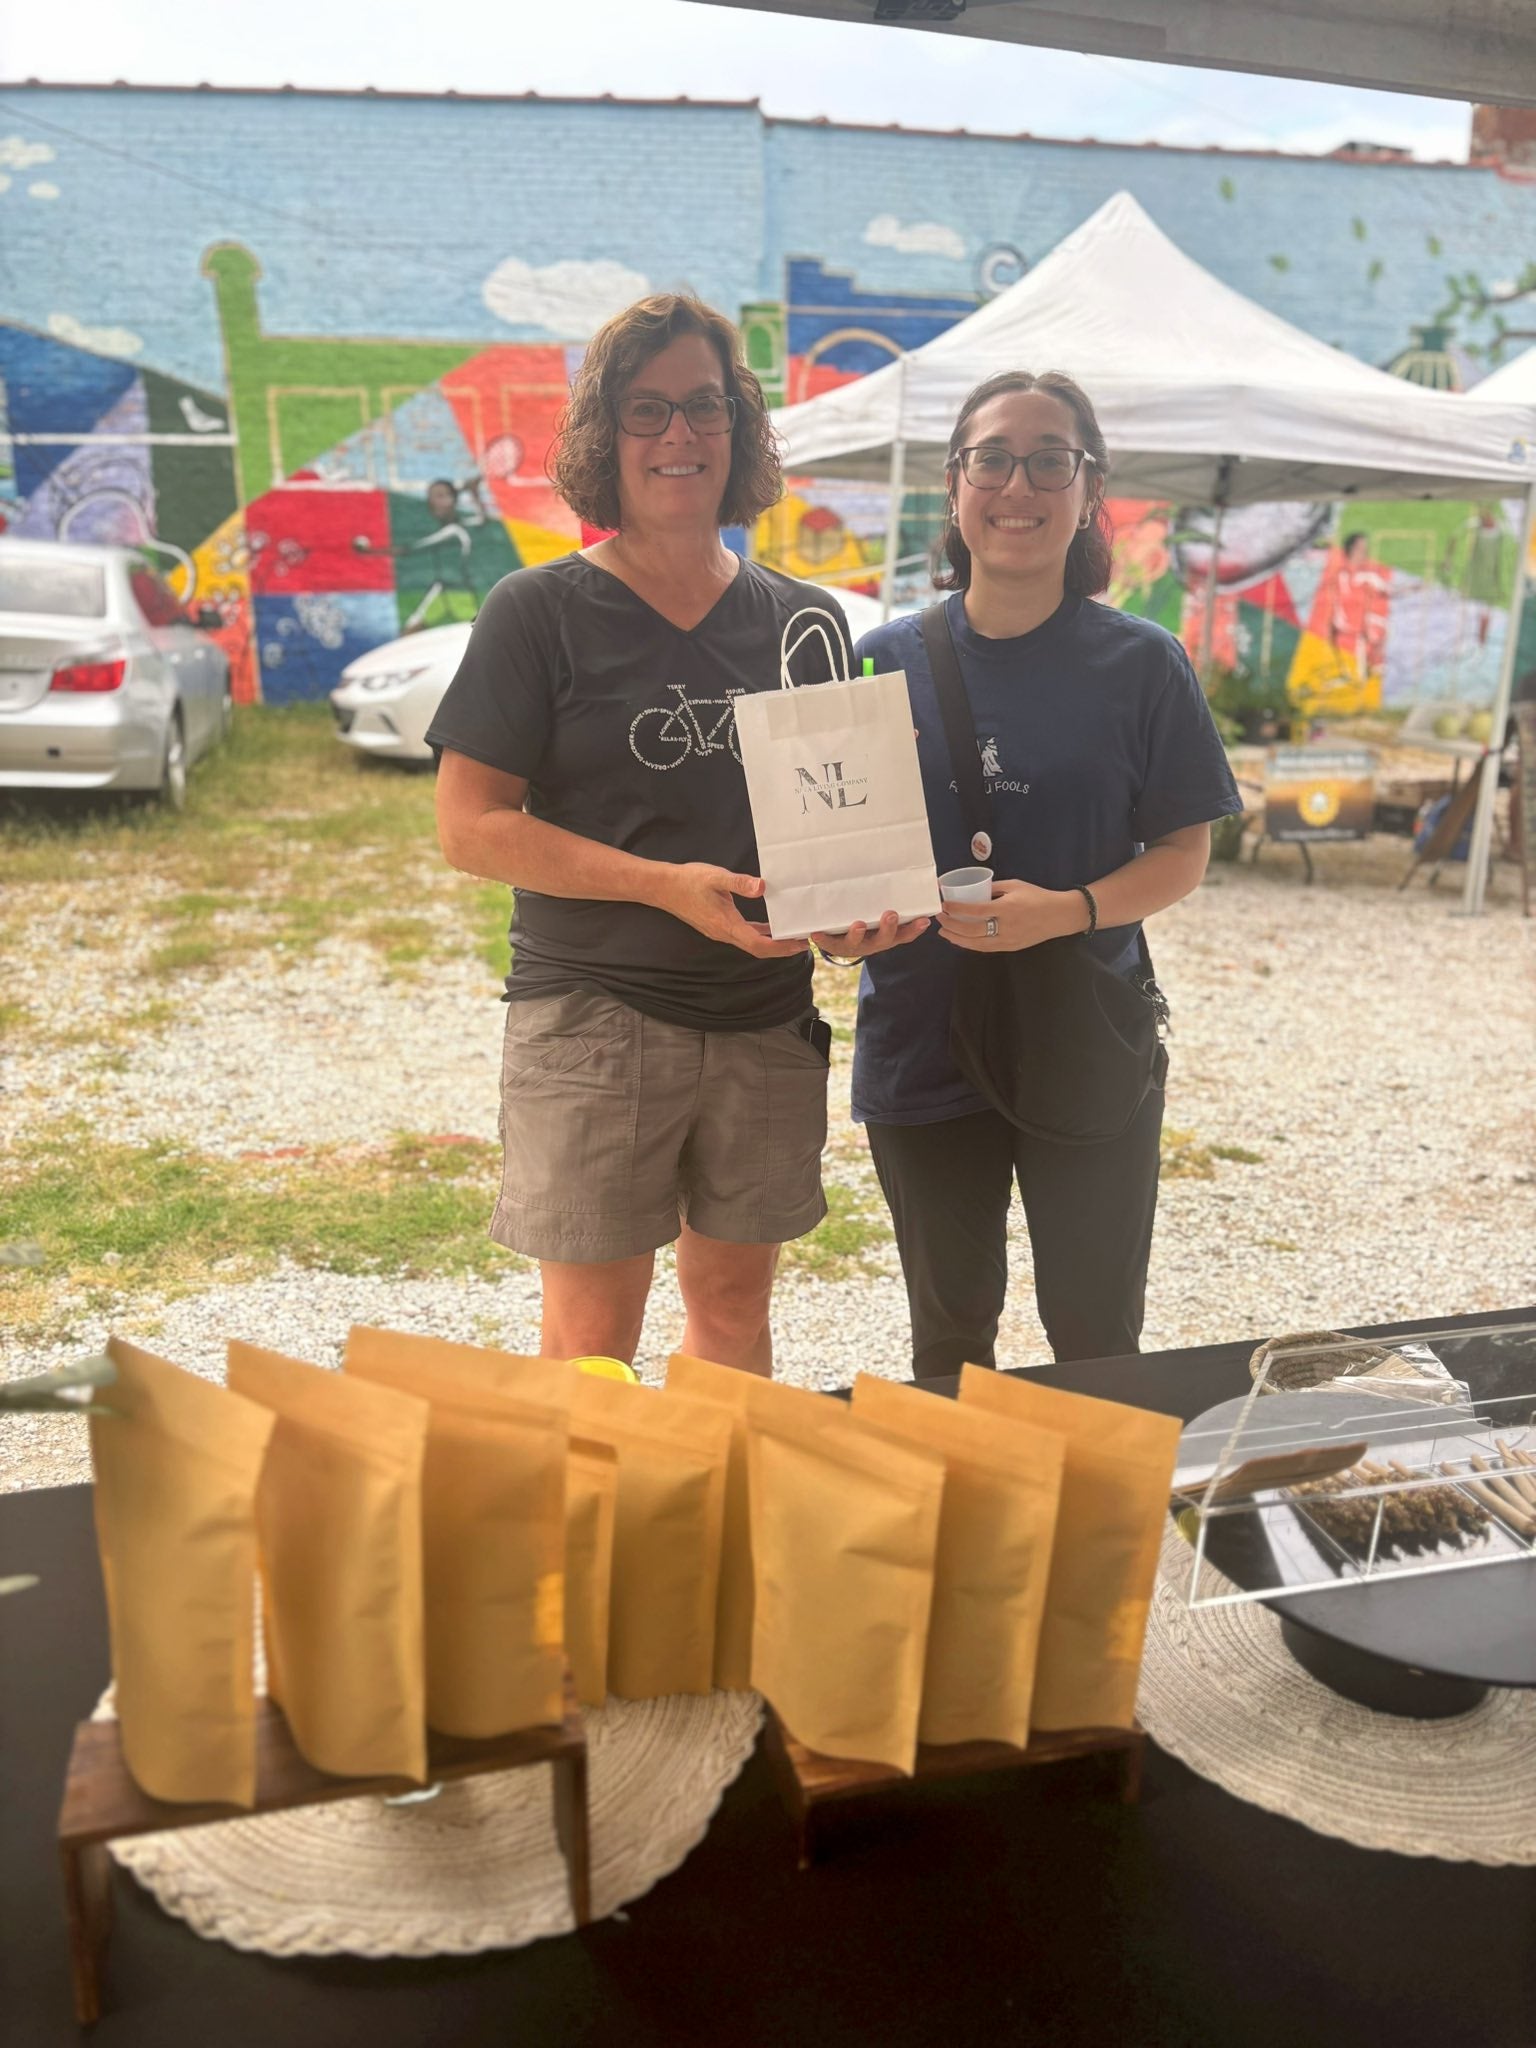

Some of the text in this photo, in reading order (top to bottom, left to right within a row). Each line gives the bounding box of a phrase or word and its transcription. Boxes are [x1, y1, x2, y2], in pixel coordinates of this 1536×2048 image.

[707, 742, 724, 750] SPEED
[813, 782, 835, 791] LIVING
[836, 777, 869, 788] COMPANY
[994, 781, 1030, 794] FOOLS
